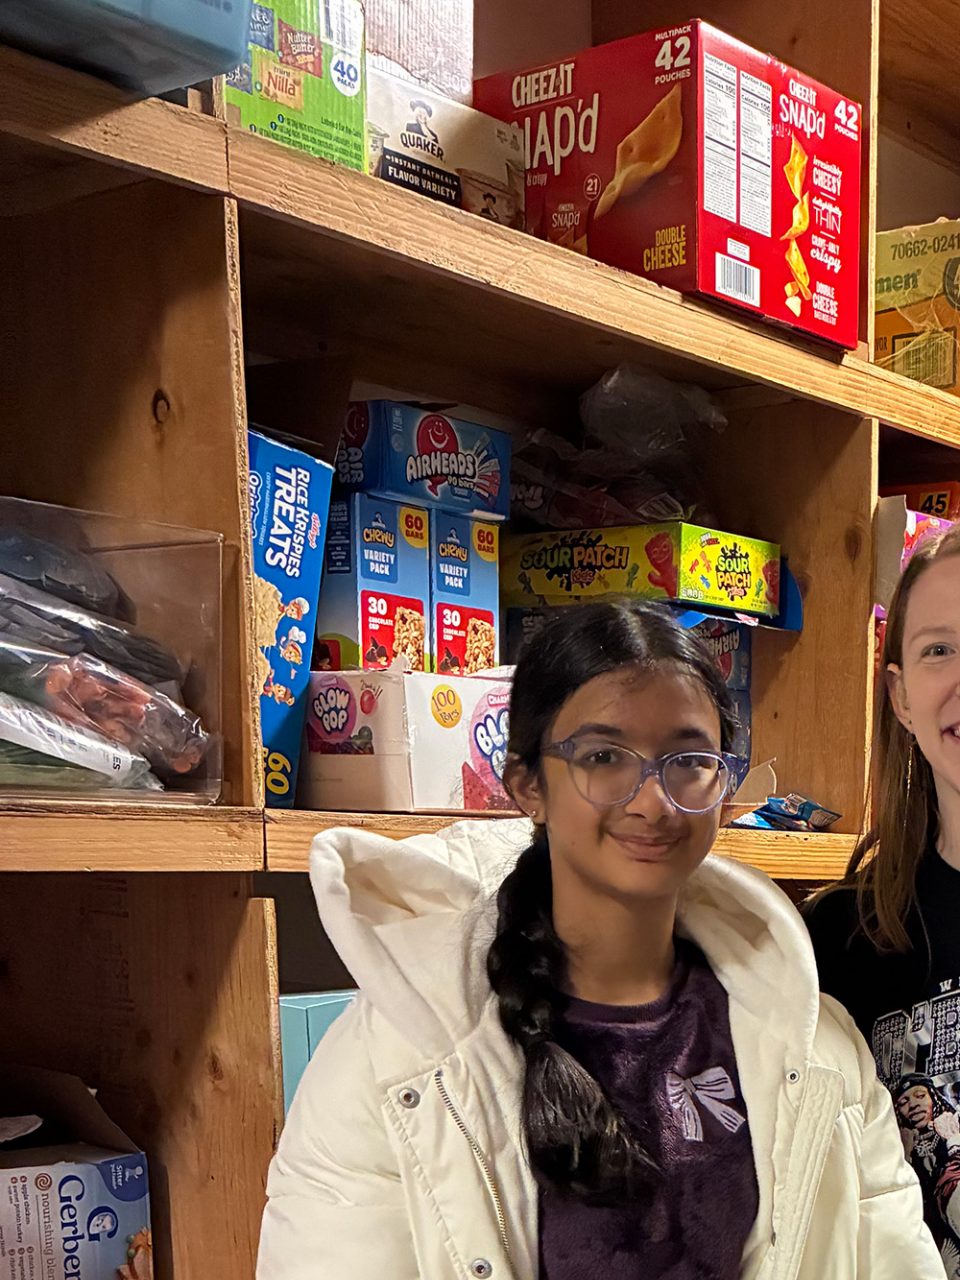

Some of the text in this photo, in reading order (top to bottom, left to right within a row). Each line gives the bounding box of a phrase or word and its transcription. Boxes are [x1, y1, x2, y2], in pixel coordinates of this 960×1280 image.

[287, 32, 312, 44] Nutter
[290, 42, 315, 54] Butter
[655, 36, 691, 70] 42
[333, 60, 358, 82] 40
[655, 69, 691, 85] POUCHES
[267, 71, 296, 97] Nilla
[834, 100, 859, 132] 42
[400, 132, 445, 161] QUAKER
[387, 166, 457, 200] FLAVOR VARIETY
[586, 178, 598, 192] 21
[812, 166, 842, 196] CHEESY
[813, 206, 841, 234] THIN
[655, 224, 686, 247] DOUBLE
[643, 241, 687, 272] CHEESE
[810, 248, 842, 274] crispy
[812, 291, 839, 317] CHEESE
[406, 451, 478, 484] AIRHEADS
[921, 493, 948, 514] 45
[265, 466, 298, 569] TREATS
[285, 467, 311, 579] RICE KRISPIES
[405, 514, 424, 532] 60
[405, 530, 424, 541] BARS
[477, 528, 494, 546] 60
[364, 549, 396, 565] VARIETY
[477, 543, 495, 554] BARS
[520, 544, 630, 570] SOUR PATCH
[369, 562, 391, 576] PACK
[439, 563, 468, 579] VARIETY
[717, 556, 750, 573] SOUR
[444, 576, 464, 589] PACK
[716, 571, 751, 589] PATCH
[368, 596, 388, 616] 30
[443, 608, 461, 627] 30
[312, 687, 351, 719] BLOW
[431, 688, 456, 712] 100
[322, 709, 349, 733] POP
[474, 708, 510, 757] BLO
[266, 752, 292, 795] 60
[41, 1193, 55, 1257] nourishing
